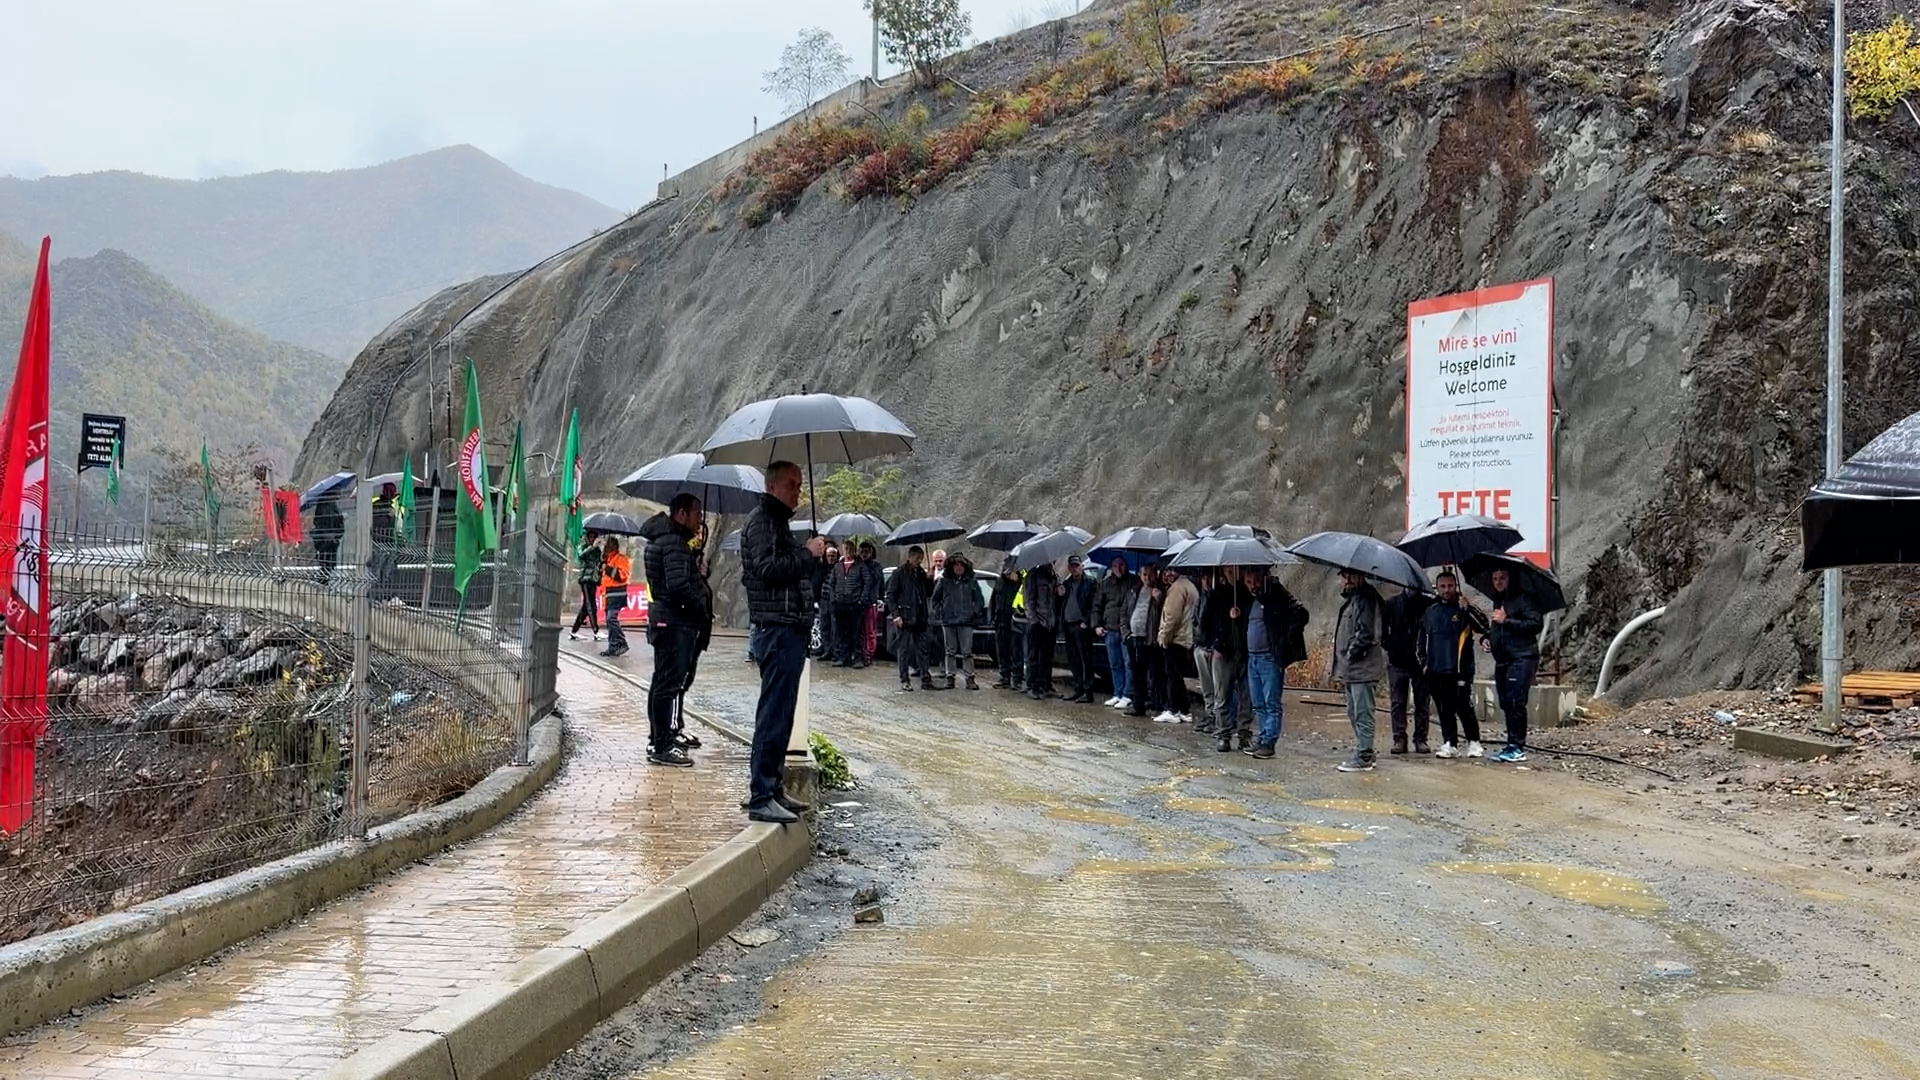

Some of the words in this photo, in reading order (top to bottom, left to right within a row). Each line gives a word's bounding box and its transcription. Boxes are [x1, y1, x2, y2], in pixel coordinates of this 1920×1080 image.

[1438, 335, 1468, 353] Mirë
[1472, 335, 1487, 348] se
[1492, 327, 1517, 345] vini
[1439, 352, 1516, 376] Hoşgeldiniz
[1445, 379, 1507, 396] Welcome
[1449, 450, 1471, 459] Please
[1472, 448, 1500, 458] observe
[1437, 461, 1449, 470] the
[1450, 460, 1470, 469] safety
